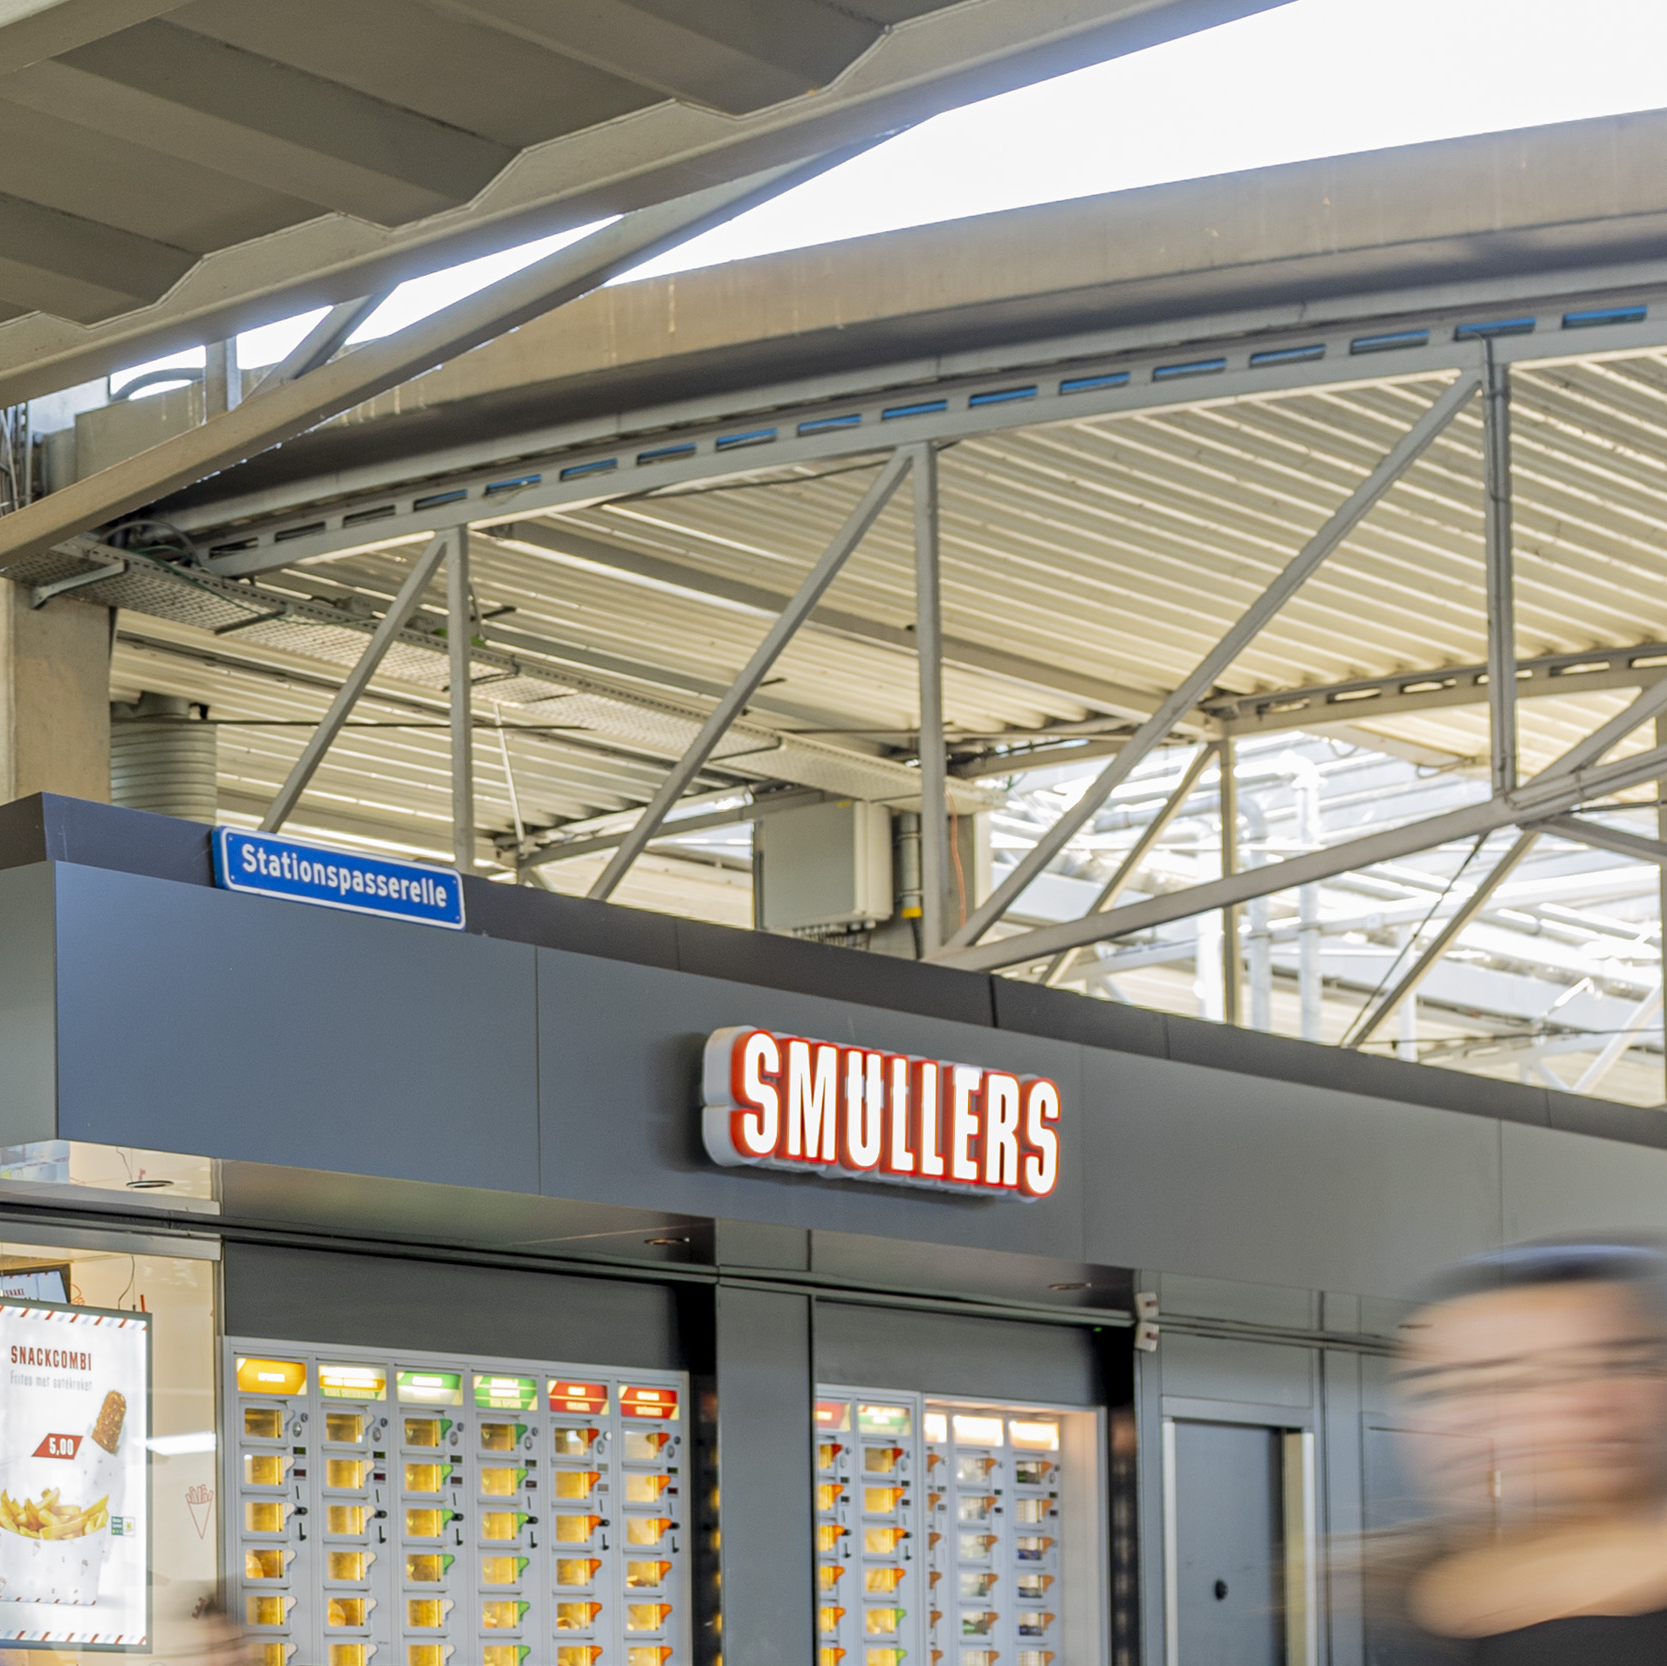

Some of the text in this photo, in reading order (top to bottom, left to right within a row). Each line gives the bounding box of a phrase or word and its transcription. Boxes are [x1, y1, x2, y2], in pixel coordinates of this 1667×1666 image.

[241, 843, 447, 908] Stationspasserelle
[731, 1029, 1061, 1197] SMULLERS
[11, 1345, 91, 1371] SNACKCOMBI
[49, 1437, 74, 1456] 5,00
